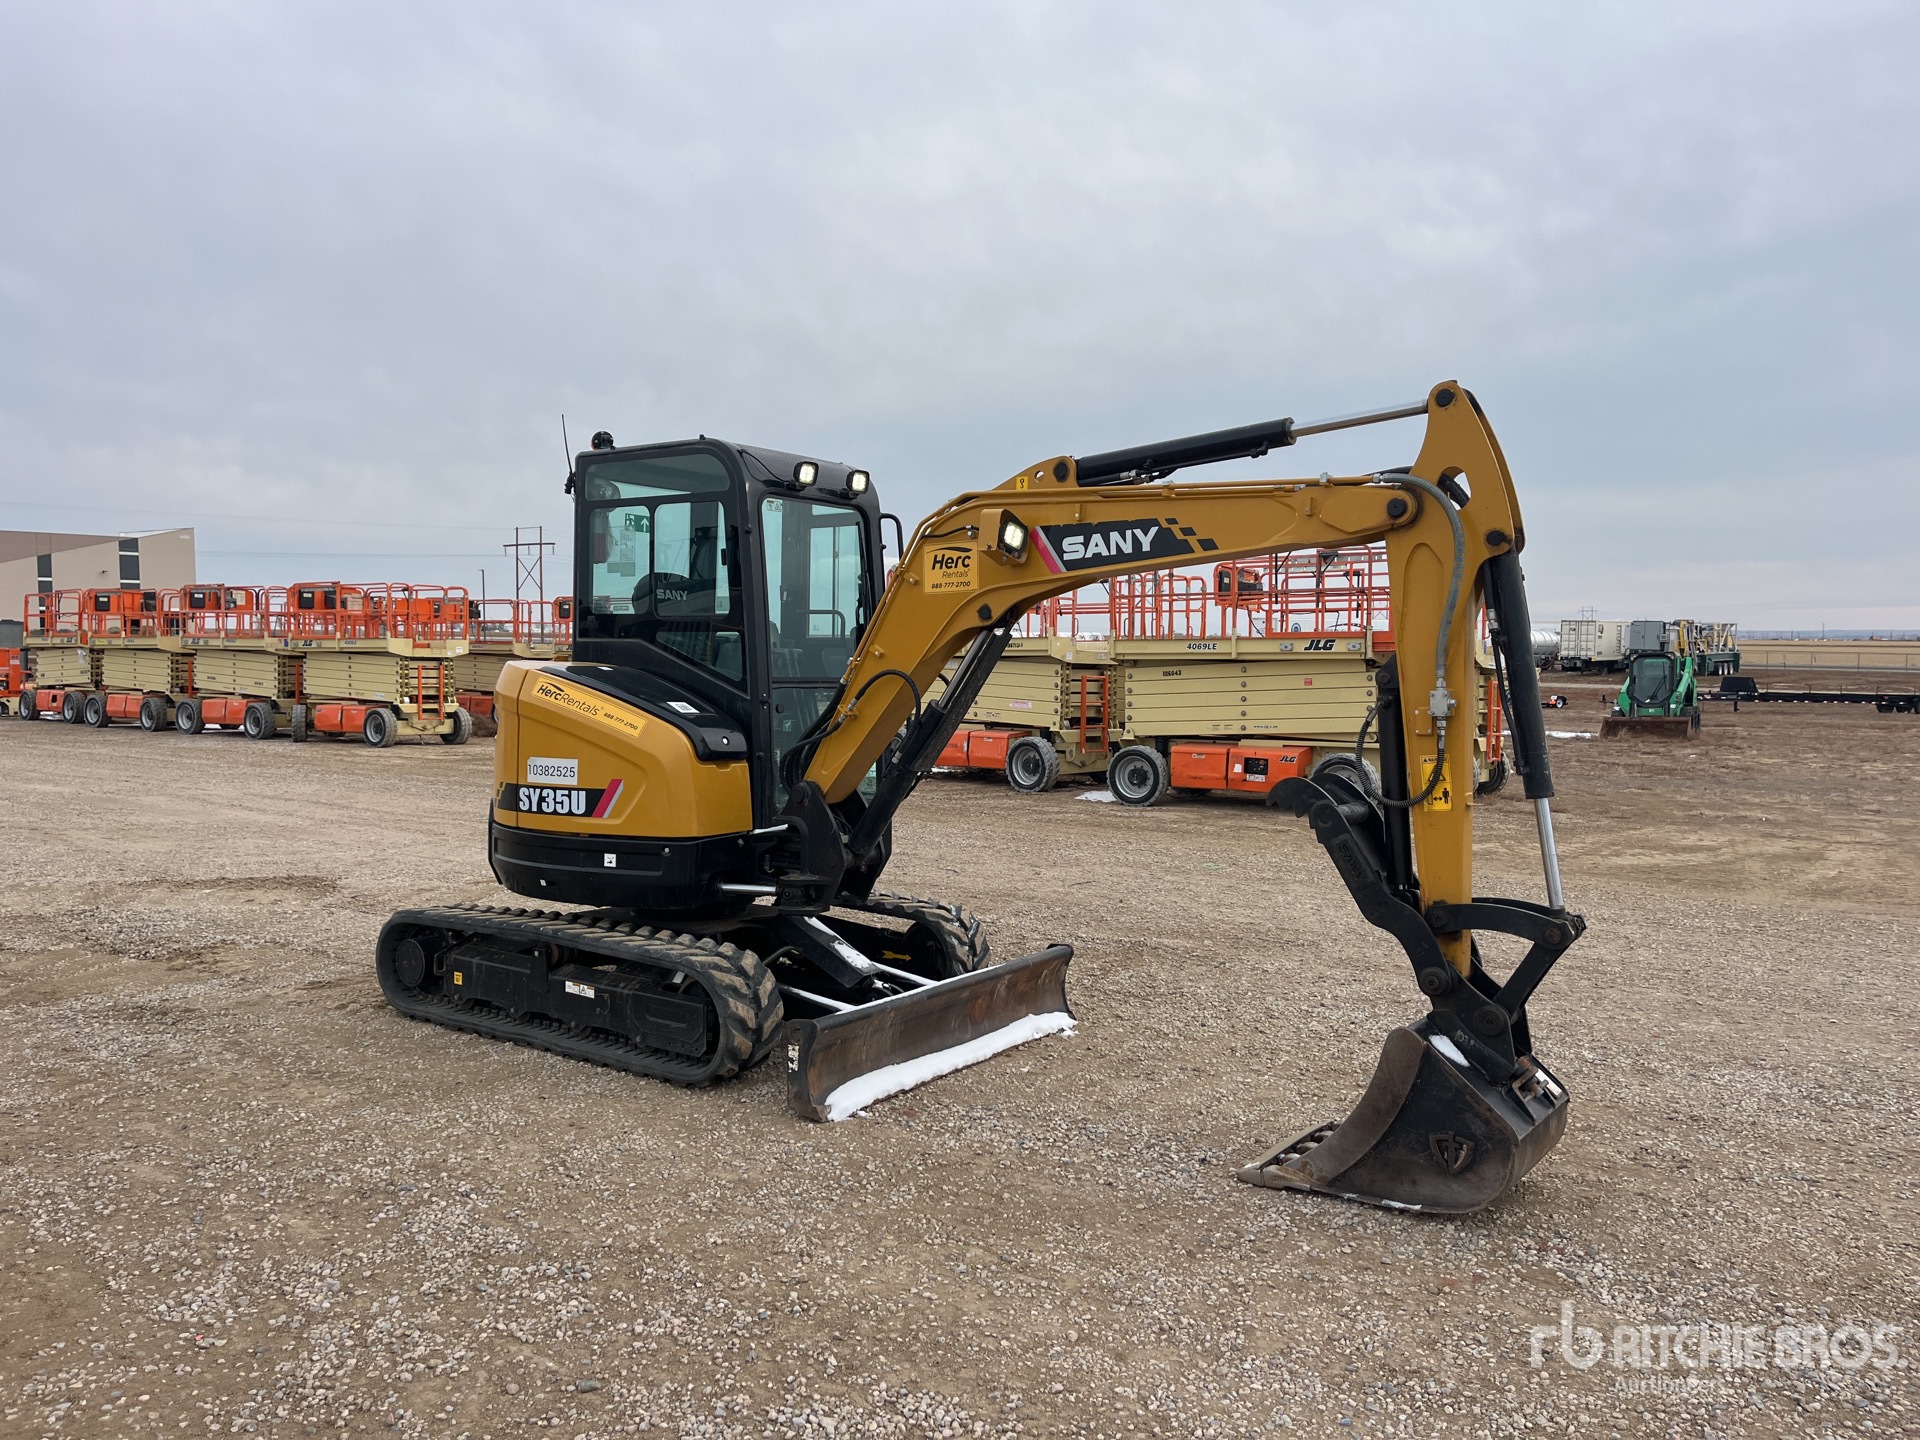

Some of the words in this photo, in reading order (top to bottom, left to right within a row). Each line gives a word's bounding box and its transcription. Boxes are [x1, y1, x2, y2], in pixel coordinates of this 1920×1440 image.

[1061, 526, 1159, 561] SANY
[931, 553, 971, 570] Herc
[942, 569, 969, 579] Rentals
[656, 588, 688, 601] SANY
[1186, 643, 1218, 651] 4069LE
[1303, 638, 1337, 652] JLG
[1278, 755, 1297, 763] JLG
[528, 764, 576, 778] 10382525
[519, 787, 586, 815] SY35U
